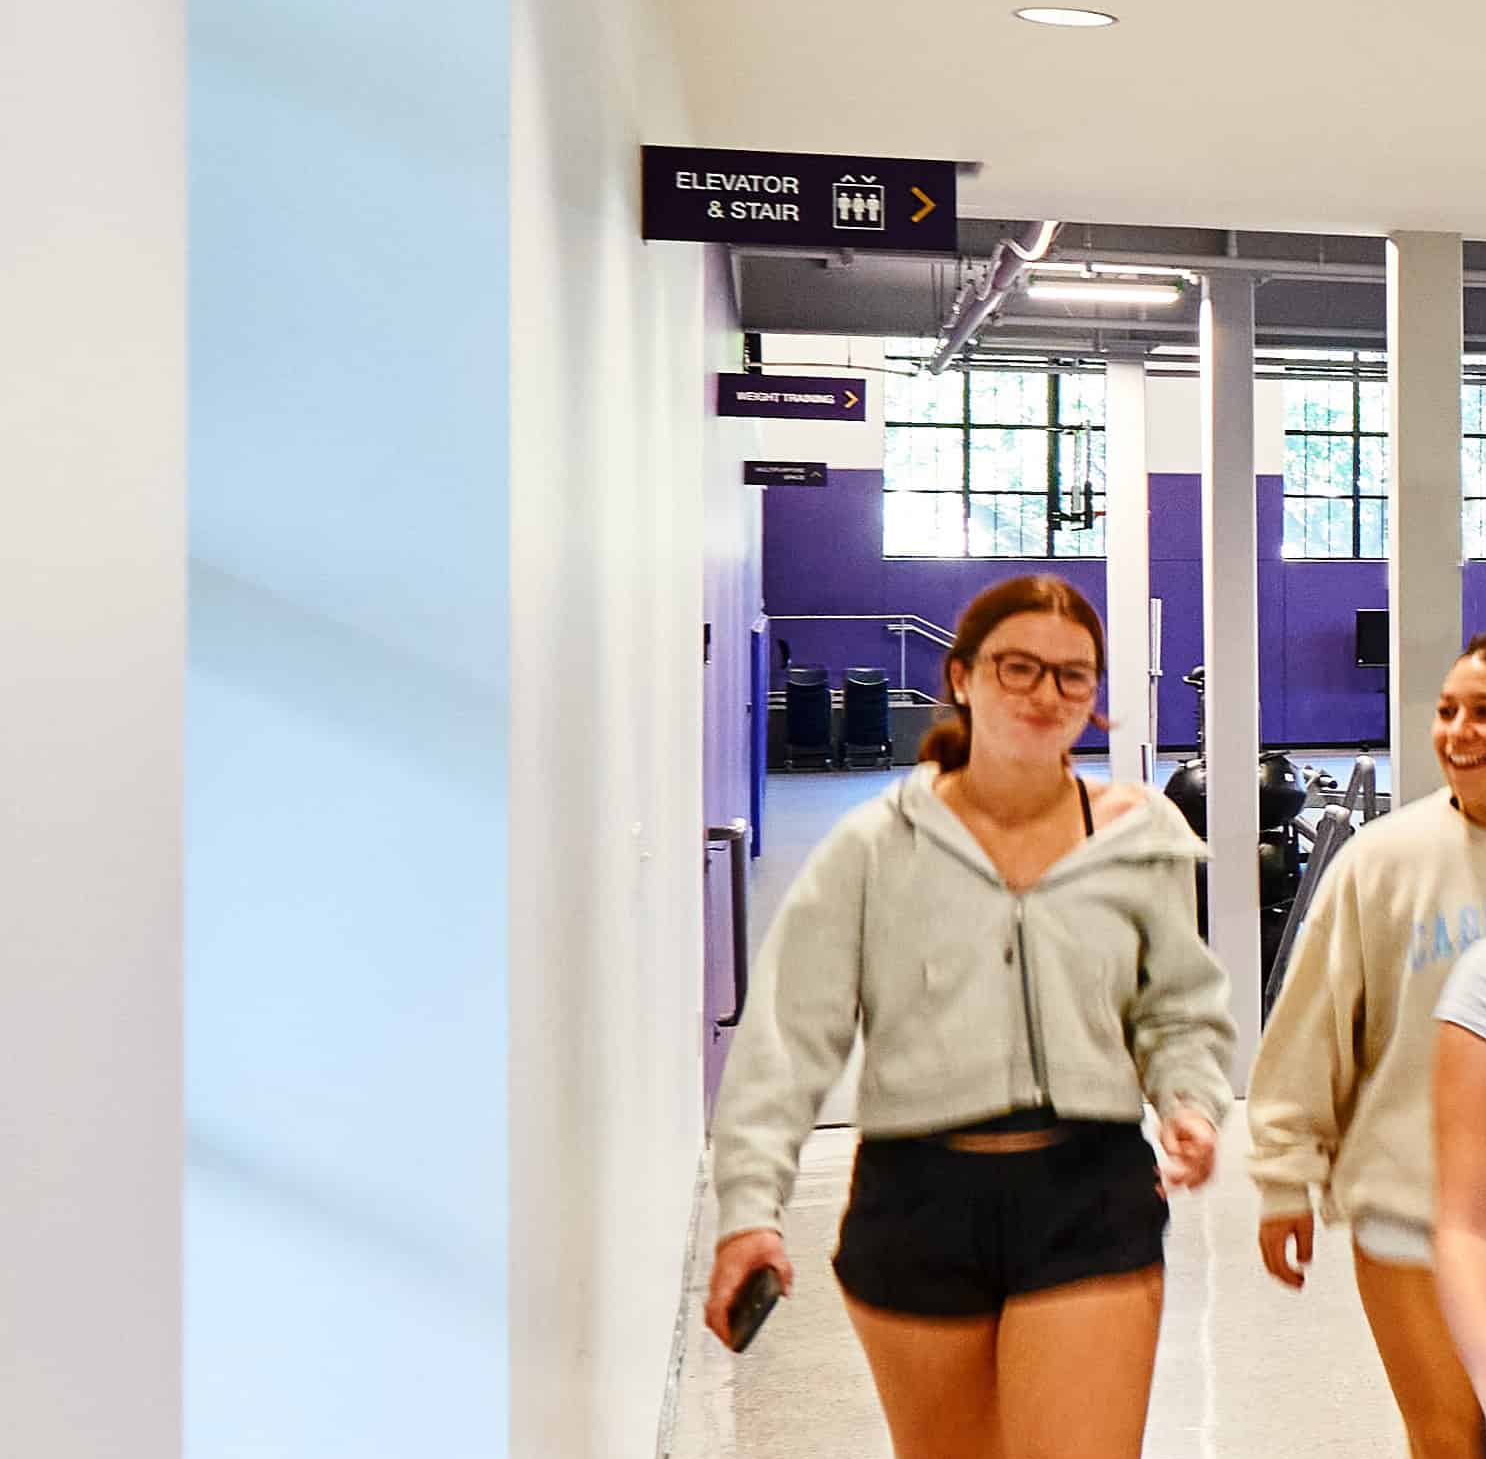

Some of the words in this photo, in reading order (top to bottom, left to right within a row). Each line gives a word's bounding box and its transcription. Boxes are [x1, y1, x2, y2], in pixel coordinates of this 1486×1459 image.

[675, 171, 799, 194] ELEVATOR
[707, 200, 724, 219] &
[730, 201, 800, 222] STAIR
